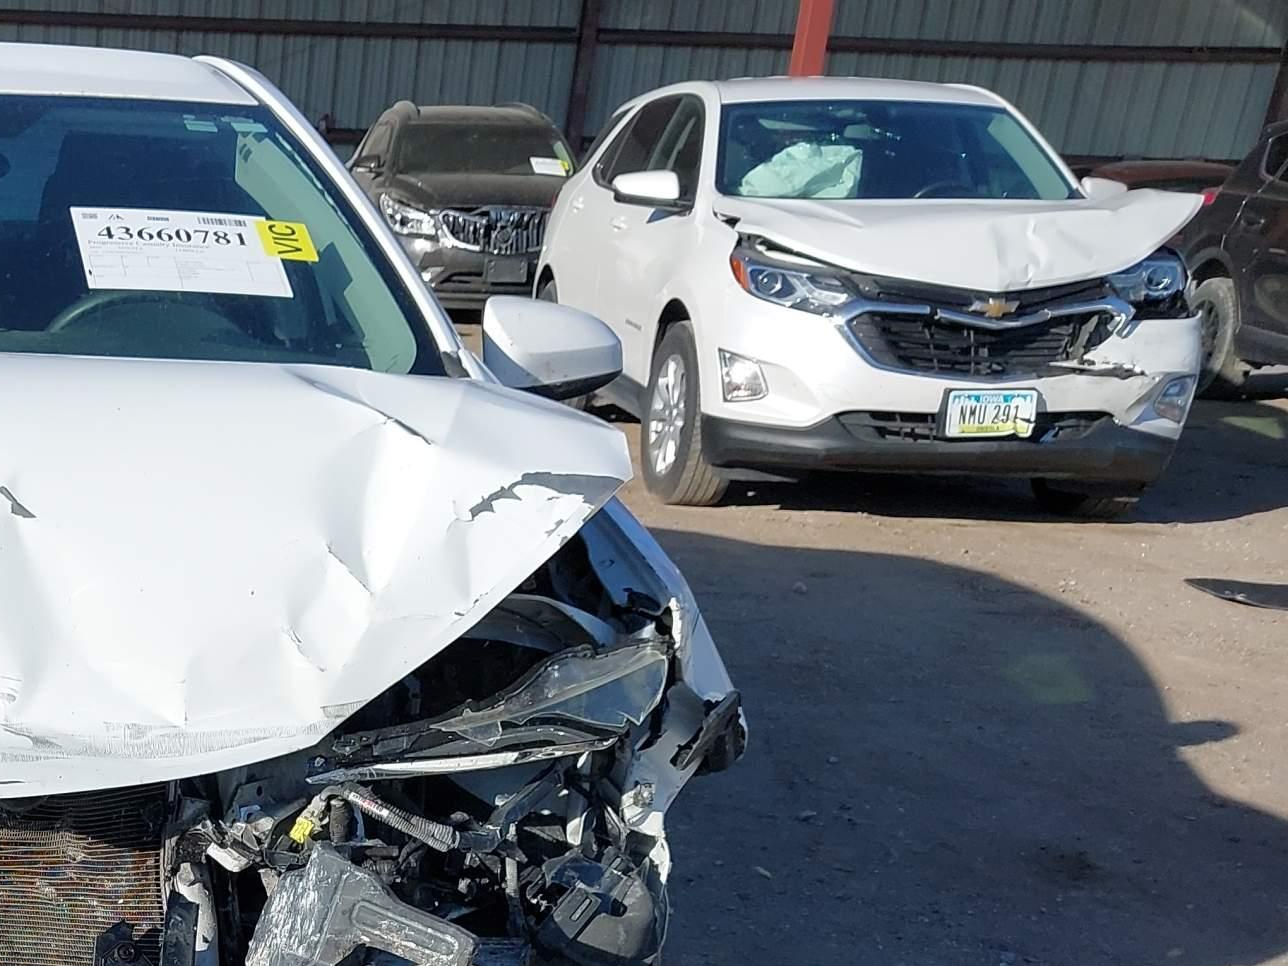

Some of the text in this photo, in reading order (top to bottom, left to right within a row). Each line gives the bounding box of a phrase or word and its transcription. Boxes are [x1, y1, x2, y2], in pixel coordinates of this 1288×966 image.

[97, 225, 248, 247] 43660781
[267, 224, 304, 255] VIC
[980, 396, 1004, 404] IOWA
[959, 404, 1019, 425] NMU 291
